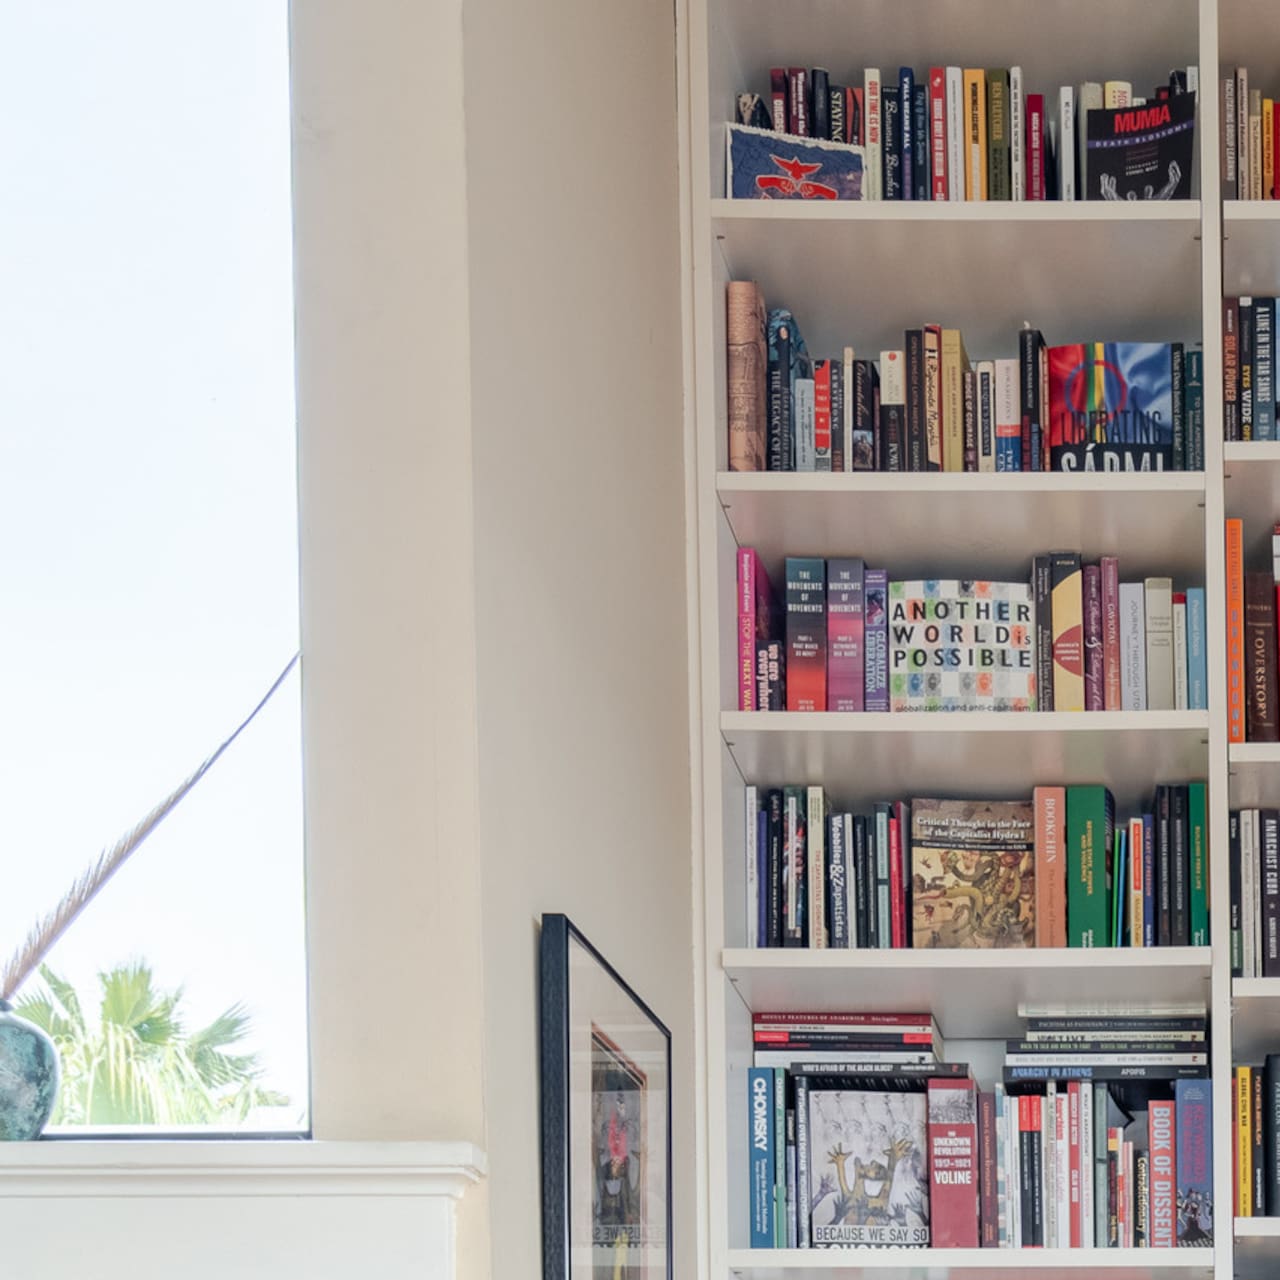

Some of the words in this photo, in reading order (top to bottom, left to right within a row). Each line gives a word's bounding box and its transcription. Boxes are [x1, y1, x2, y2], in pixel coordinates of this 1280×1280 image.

[869, 81, 878, 96] OUR
[869, 98, 879, 116] TIME
[1114, 105, 1171, 134] MUMIA
[870, 127, 879, 143] NOW
[1257, 314, 1269, 331] LINE
[1257, 334, 1269, 343] IN
[1258, 344, 1270, 359] THE
[1258, 360, 1270, 375] TAR
[856, 361, 868, 427] Orientalism
[1258, 376, 1271, 402] SANDS
[892, 602, 1030, 622] ANOTHER
[893, 625, 1010, 644] WORLD
[866, 631, 875, 692] LIBERATION
[876, 630, 886, 689] GLOBALIZE
[894, 648, 1031, 668] POSSIBLE
[1255, 638, 1266, 719] OVERSTORY
[831, 815, 842, 864] Wobblies
[1045, 797, 1056, 863] BOOKCHIN
[1265, 819, 1277, 869] ANARCHIST
[1266, 872, 1278, 895] CUBA
[833, 878, 844, 938] Zapatistas
[753, 1077, 767, 1151] CHOMSKY
[1151, 1106, 1173, 1152] BOOK
[934, 1170, 972, 1184] VOLINE
[1152, 1156, 1173, 1179] OF
[1152, 1183, 1174, 1248] DISSENT
[816, 1227, 864, 1241] BECAUSE
[869, 1227, 885, 1241] WE
[889, 1227, 909, 1241] SAY
[912, 1228, 927, 1241] SO
